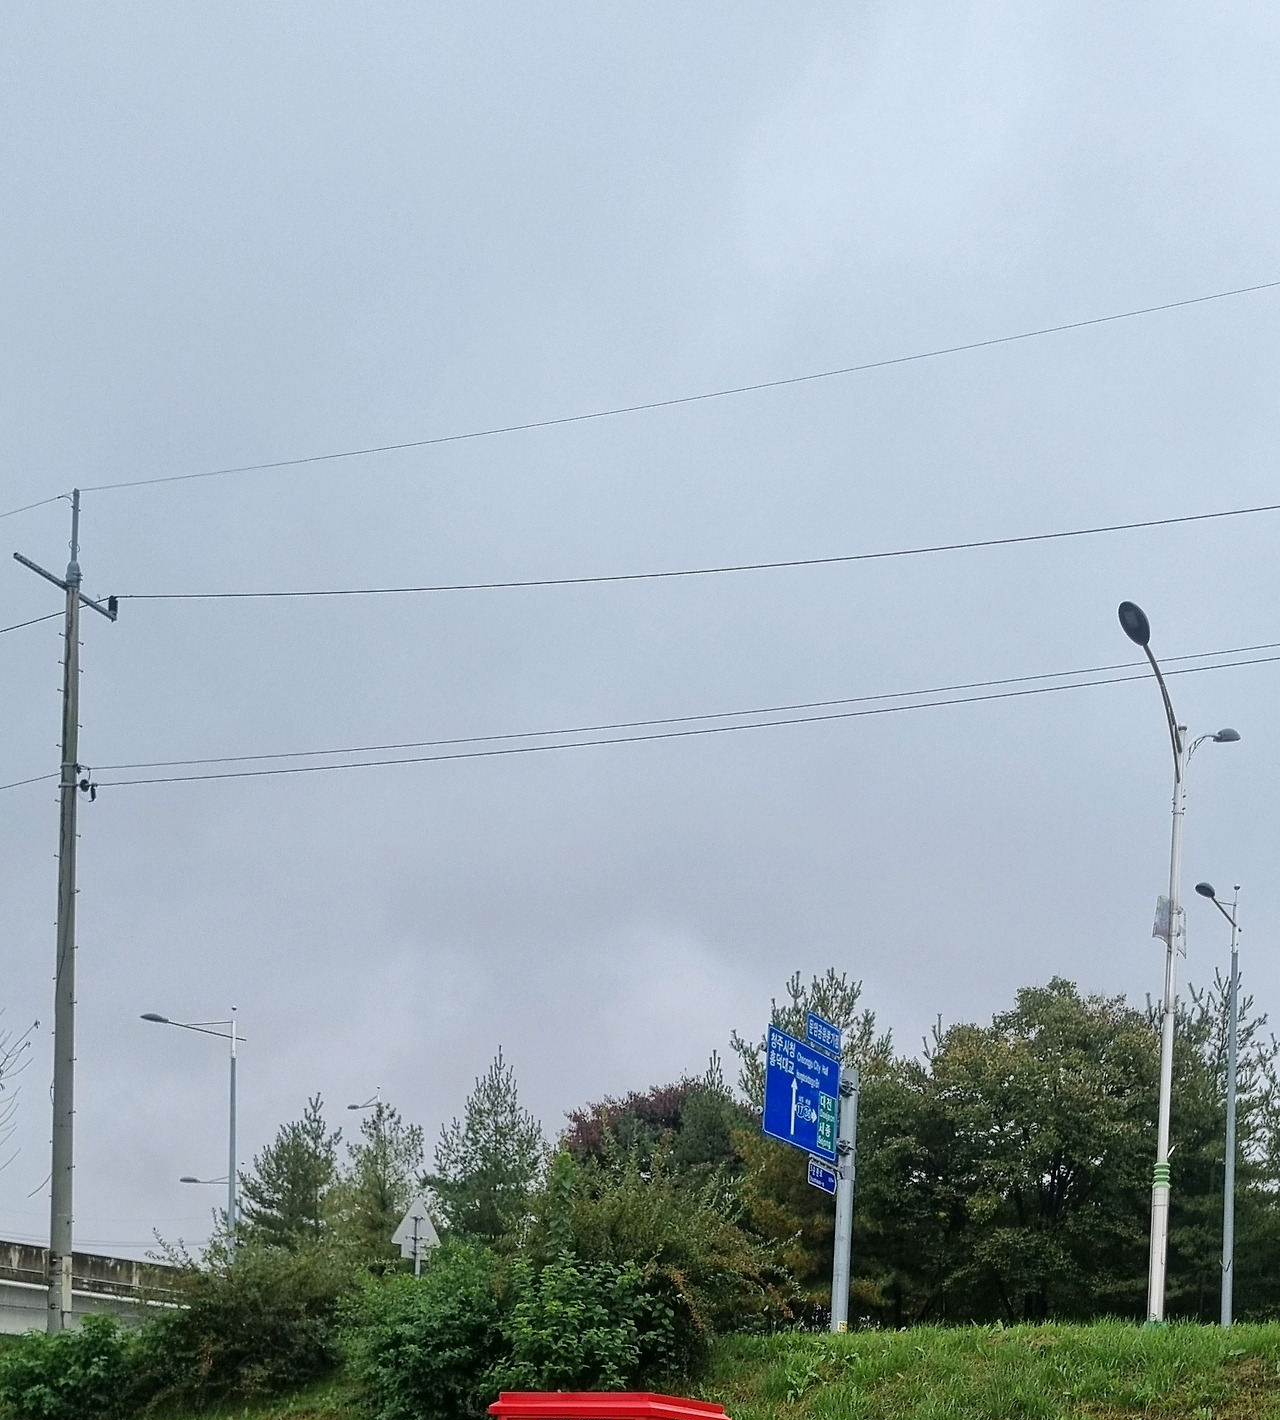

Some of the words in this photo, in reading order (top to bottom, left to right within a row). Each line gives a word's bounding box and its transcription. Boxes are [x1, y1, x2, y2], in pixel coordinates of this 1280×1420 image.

[771, 1032, 796, 1058] 청주시청
[770, 1050, 795, 1075] 흥덕대교
[821, 1095, 832, 1111] 대전
[819, 1122, 831, 1138] 세종
